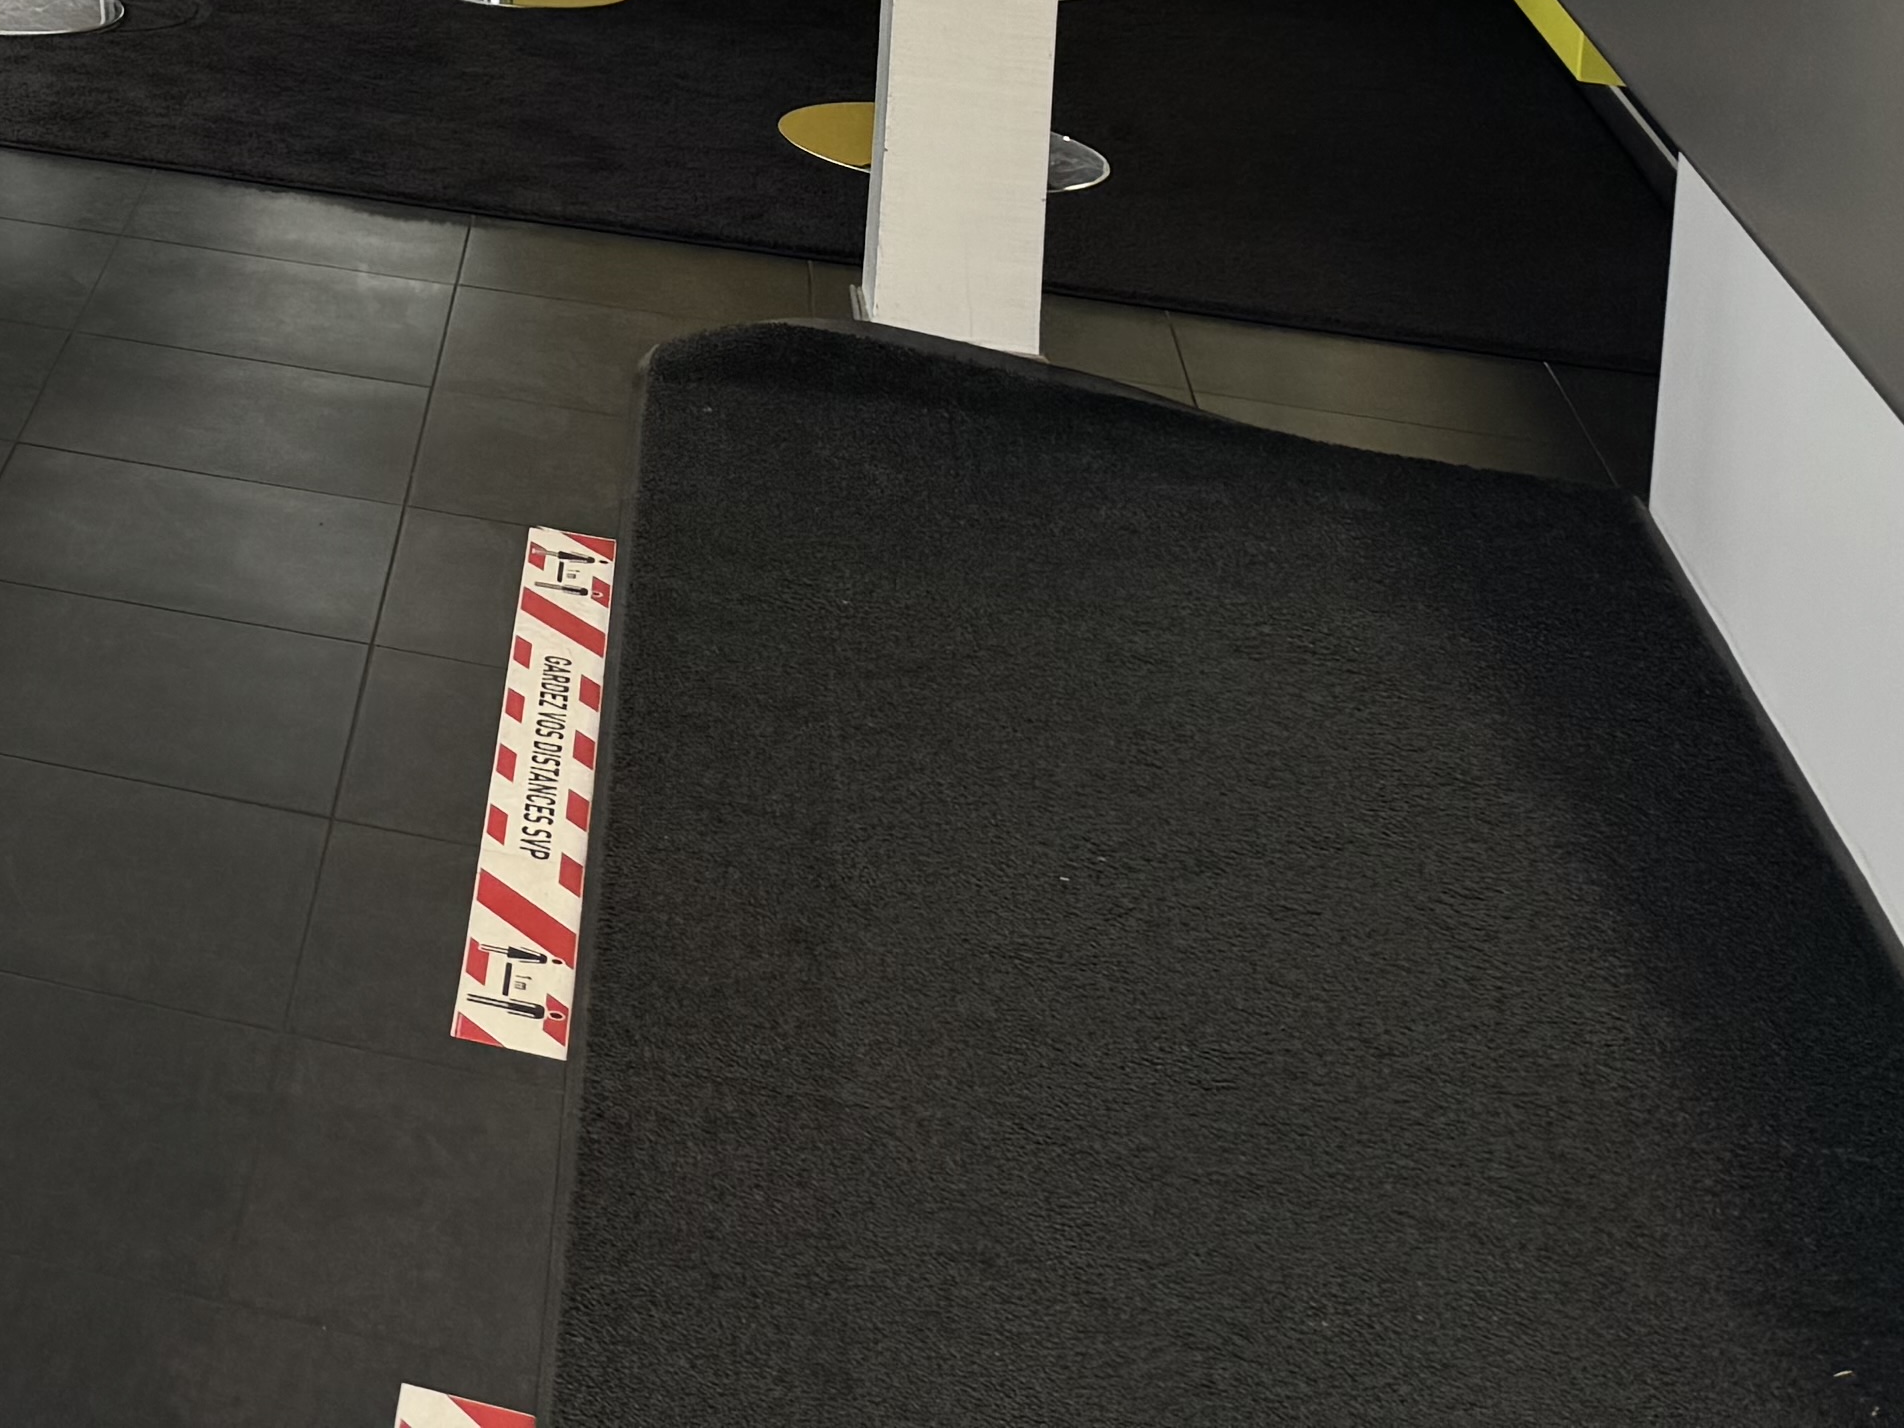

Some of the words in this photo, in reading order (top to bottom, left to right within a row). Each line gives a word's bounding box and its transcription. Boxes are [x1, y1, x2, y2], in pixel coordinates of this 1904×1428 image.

[538, 655, 573, 710] GARDEZ
[535, 711, 567, 740] VOS
[522, 741, 564, 826] DISTANCES
[519, 826, 552, 860] SVP
